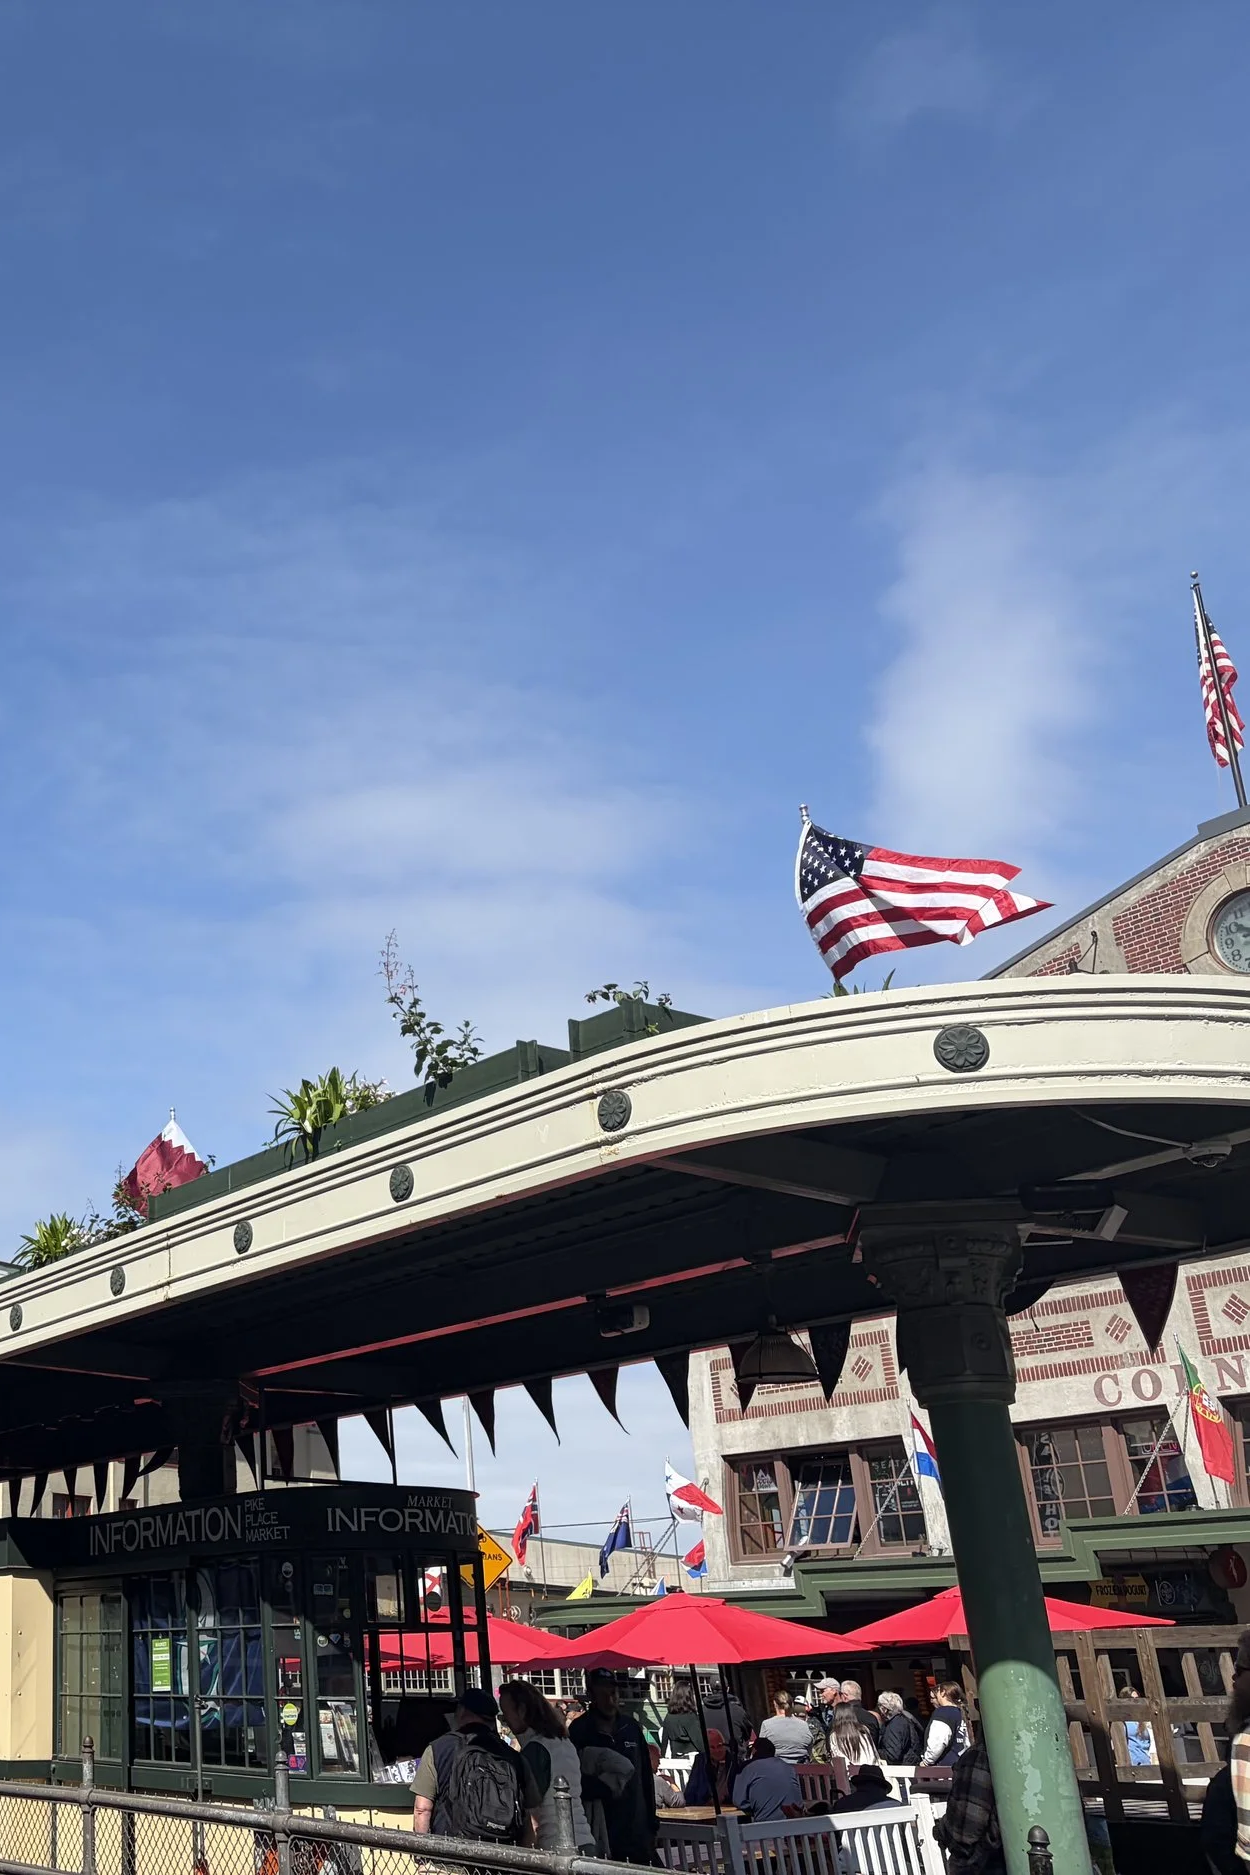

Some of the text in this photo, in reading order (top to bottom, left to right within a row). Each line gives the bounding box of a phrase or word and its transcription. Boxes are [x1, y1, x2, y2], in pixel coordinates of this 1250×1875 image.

[1224, 937, 1234, 949] 9
[1231, 949, 1242, 961] 8
[244, 1497, 266, 1512] PIKE
[407, 1495, 454, 1509] MARKET
[245, 1511, 279, 1528] PLACE
[89, 1504, 242, 1556] INFORMATION
[245, 1525, 291, 1543] MARKET
